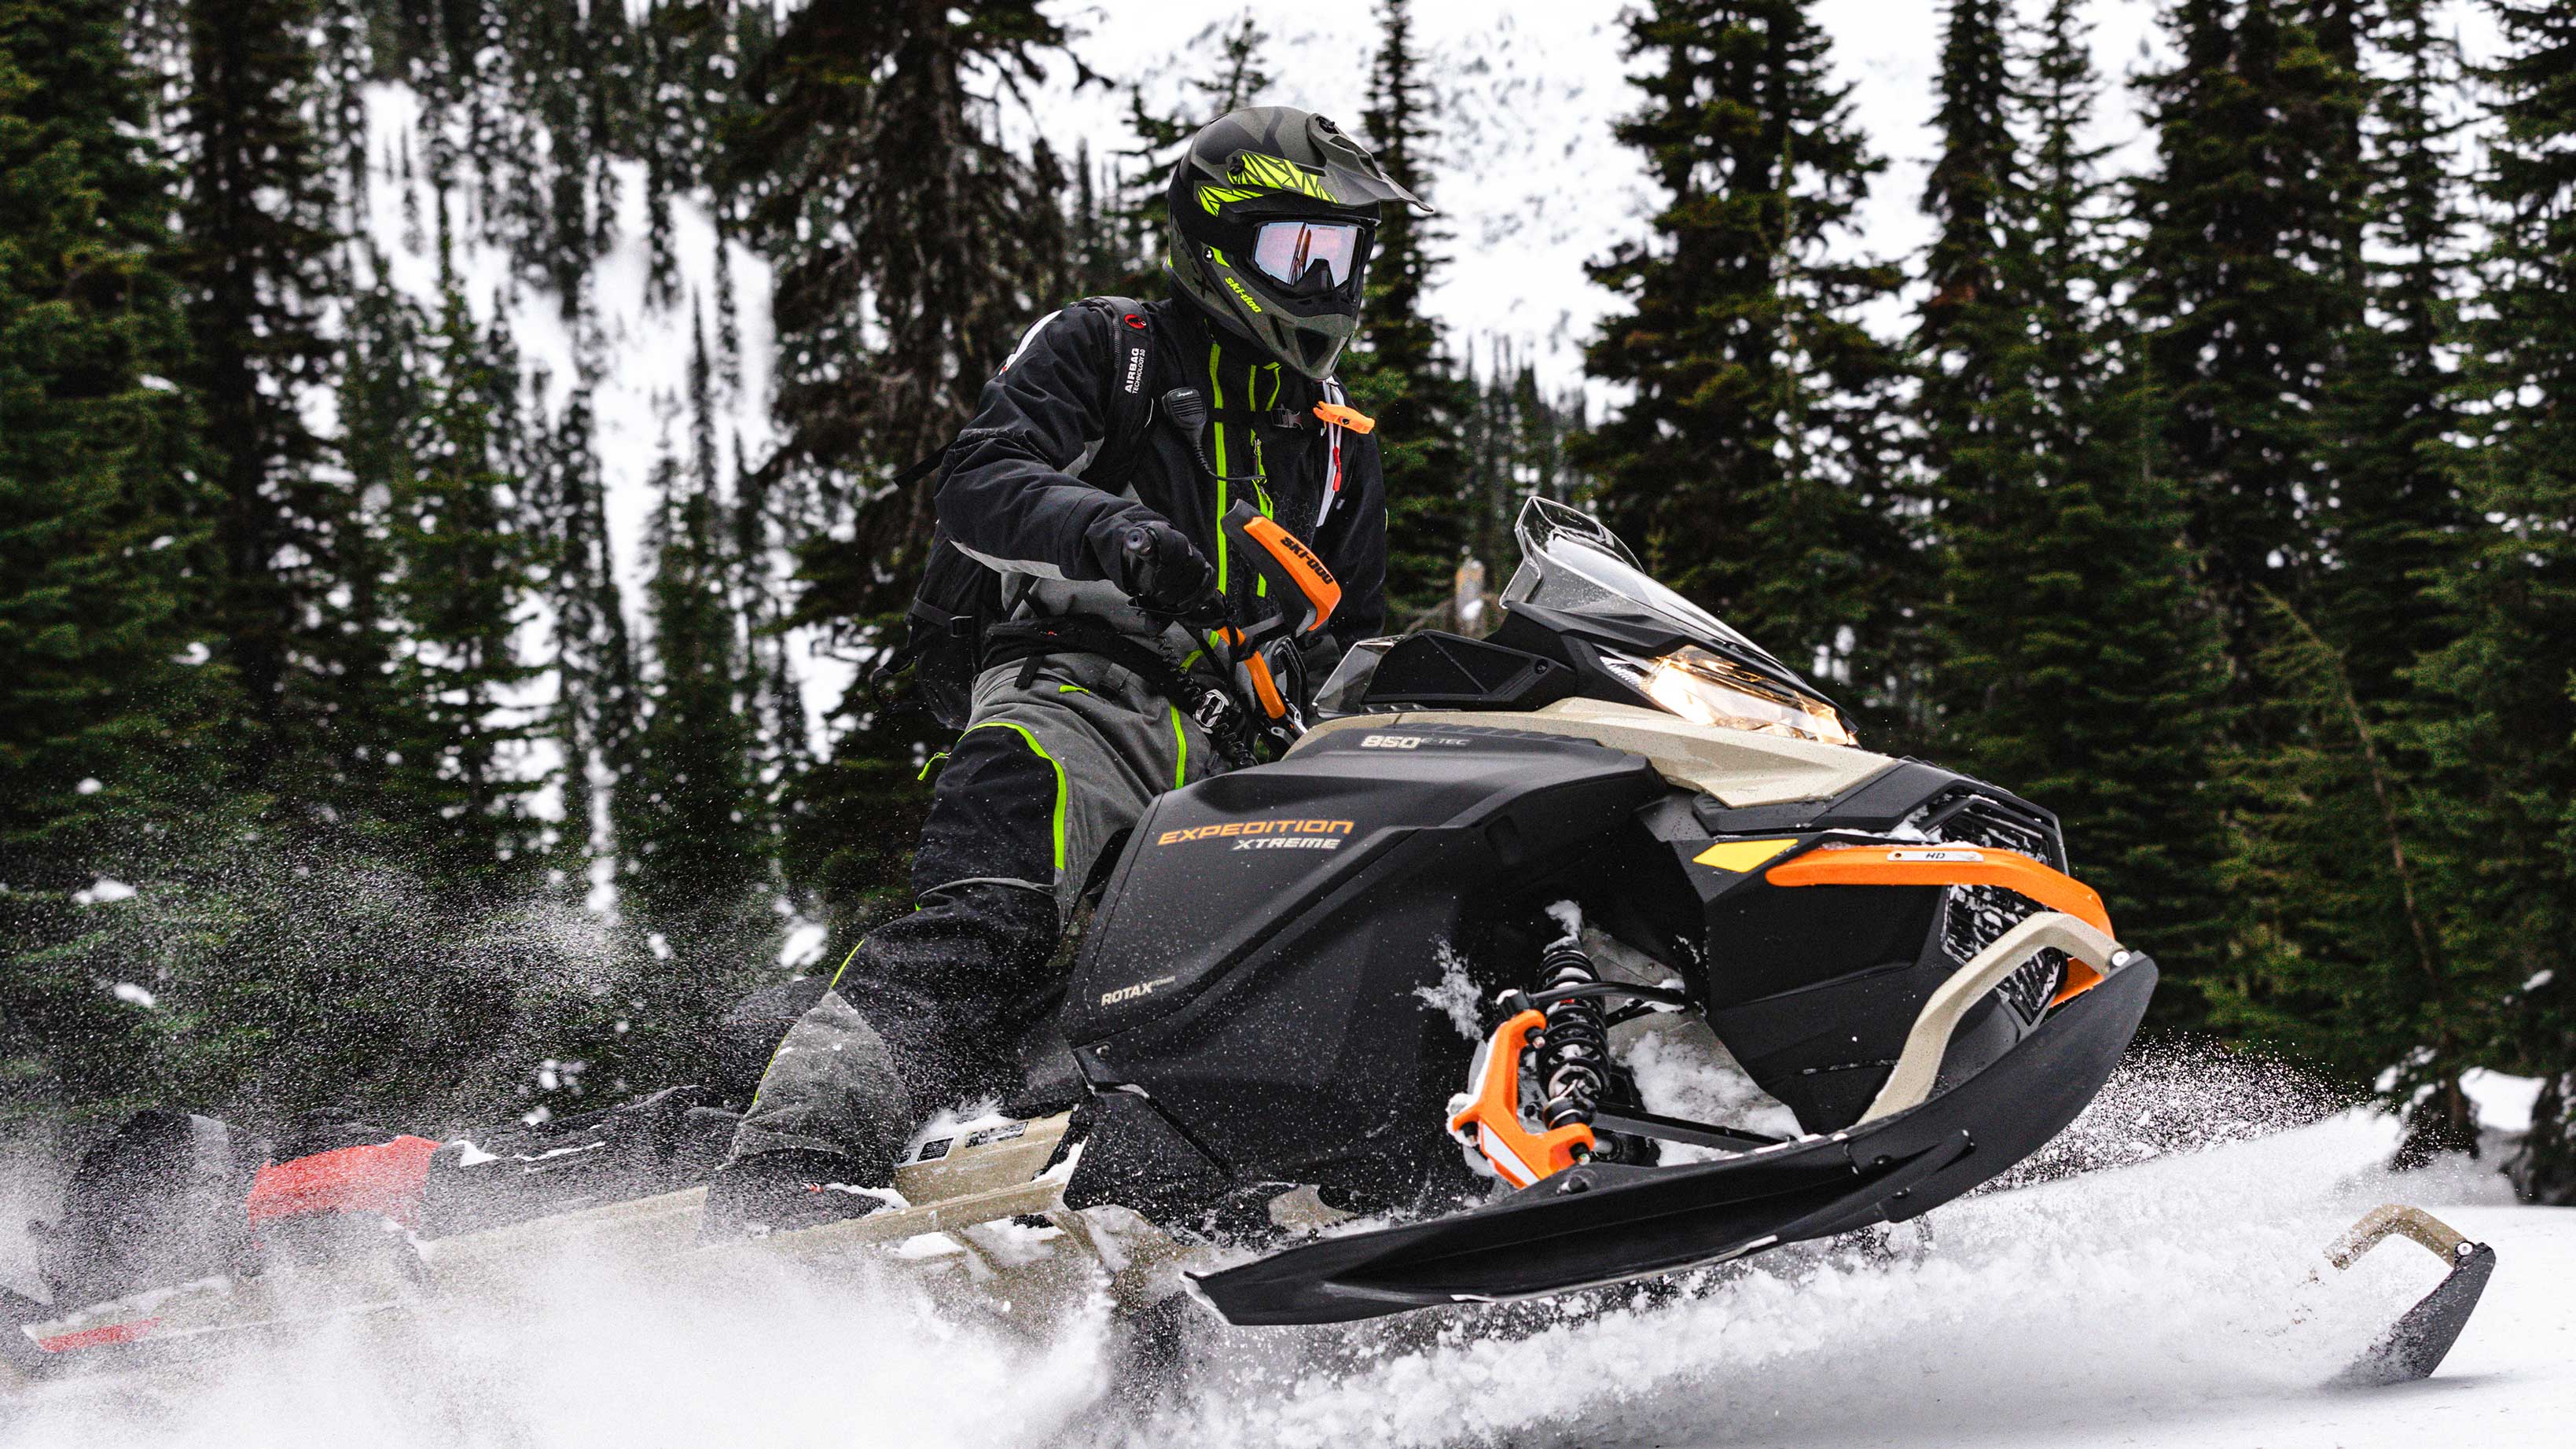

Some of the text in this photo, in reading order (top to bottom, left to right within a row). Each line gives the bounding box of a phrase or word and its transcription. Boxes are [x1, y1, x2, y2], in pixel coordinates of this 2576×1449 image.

[1225, 277, 1262, 313] ski-doo
[1125, 348, 1140, 393] AIRBAG
[1132, 356, 1145, 394] TECHNOLOGY
[1281, 536, 1333, 585] SKI-DOO
[1361, 735, 1422, 749] 850
[1157, 820, 1354, 846] EXPEDITION
[1232, 837, 1341, 851] XTREME
[1101, 981, 1153, 1007] ROTAX
